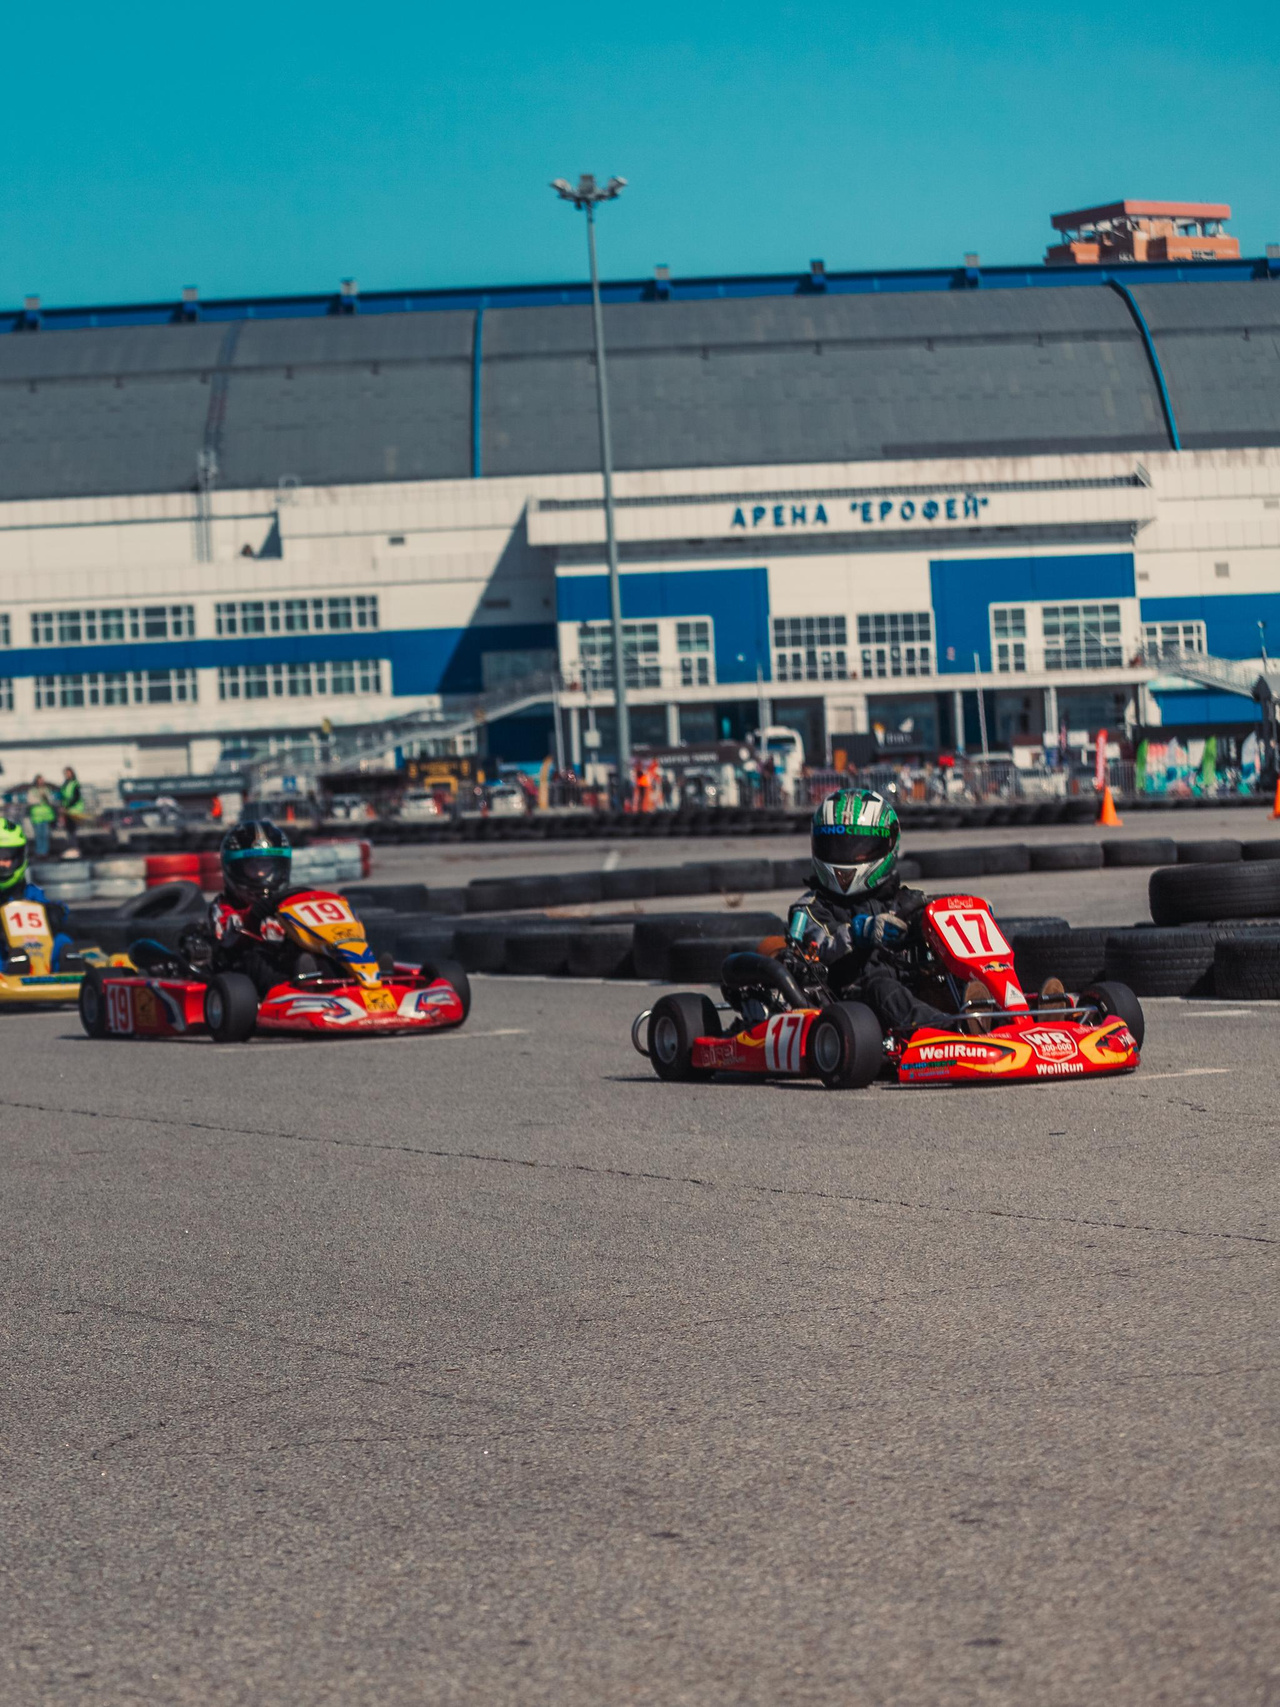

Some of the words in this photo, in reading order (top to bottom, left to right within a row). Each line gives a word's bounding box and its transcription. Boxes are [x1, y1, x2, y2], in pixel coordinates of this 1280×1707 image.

[731, 503, 828, 529] АРЕНА
[850, 492, 989, 524] "ЕРОФЕЙ"
[813, 824, 891, 839] ЕХНОСПЕКТР
[10, 912, 43, 928] 15
[299, 902, 346, 924] 19
[944, 913, 994, 954] 17
[109, 986, 130, 1031] 19
[771, 1016, 801, 1071] 17
[1025, 1032, 1072, 1045] WR
[919, 1044, 987, 1060] WellRun
[1036, 1062, 1084, 1075] WellRun
